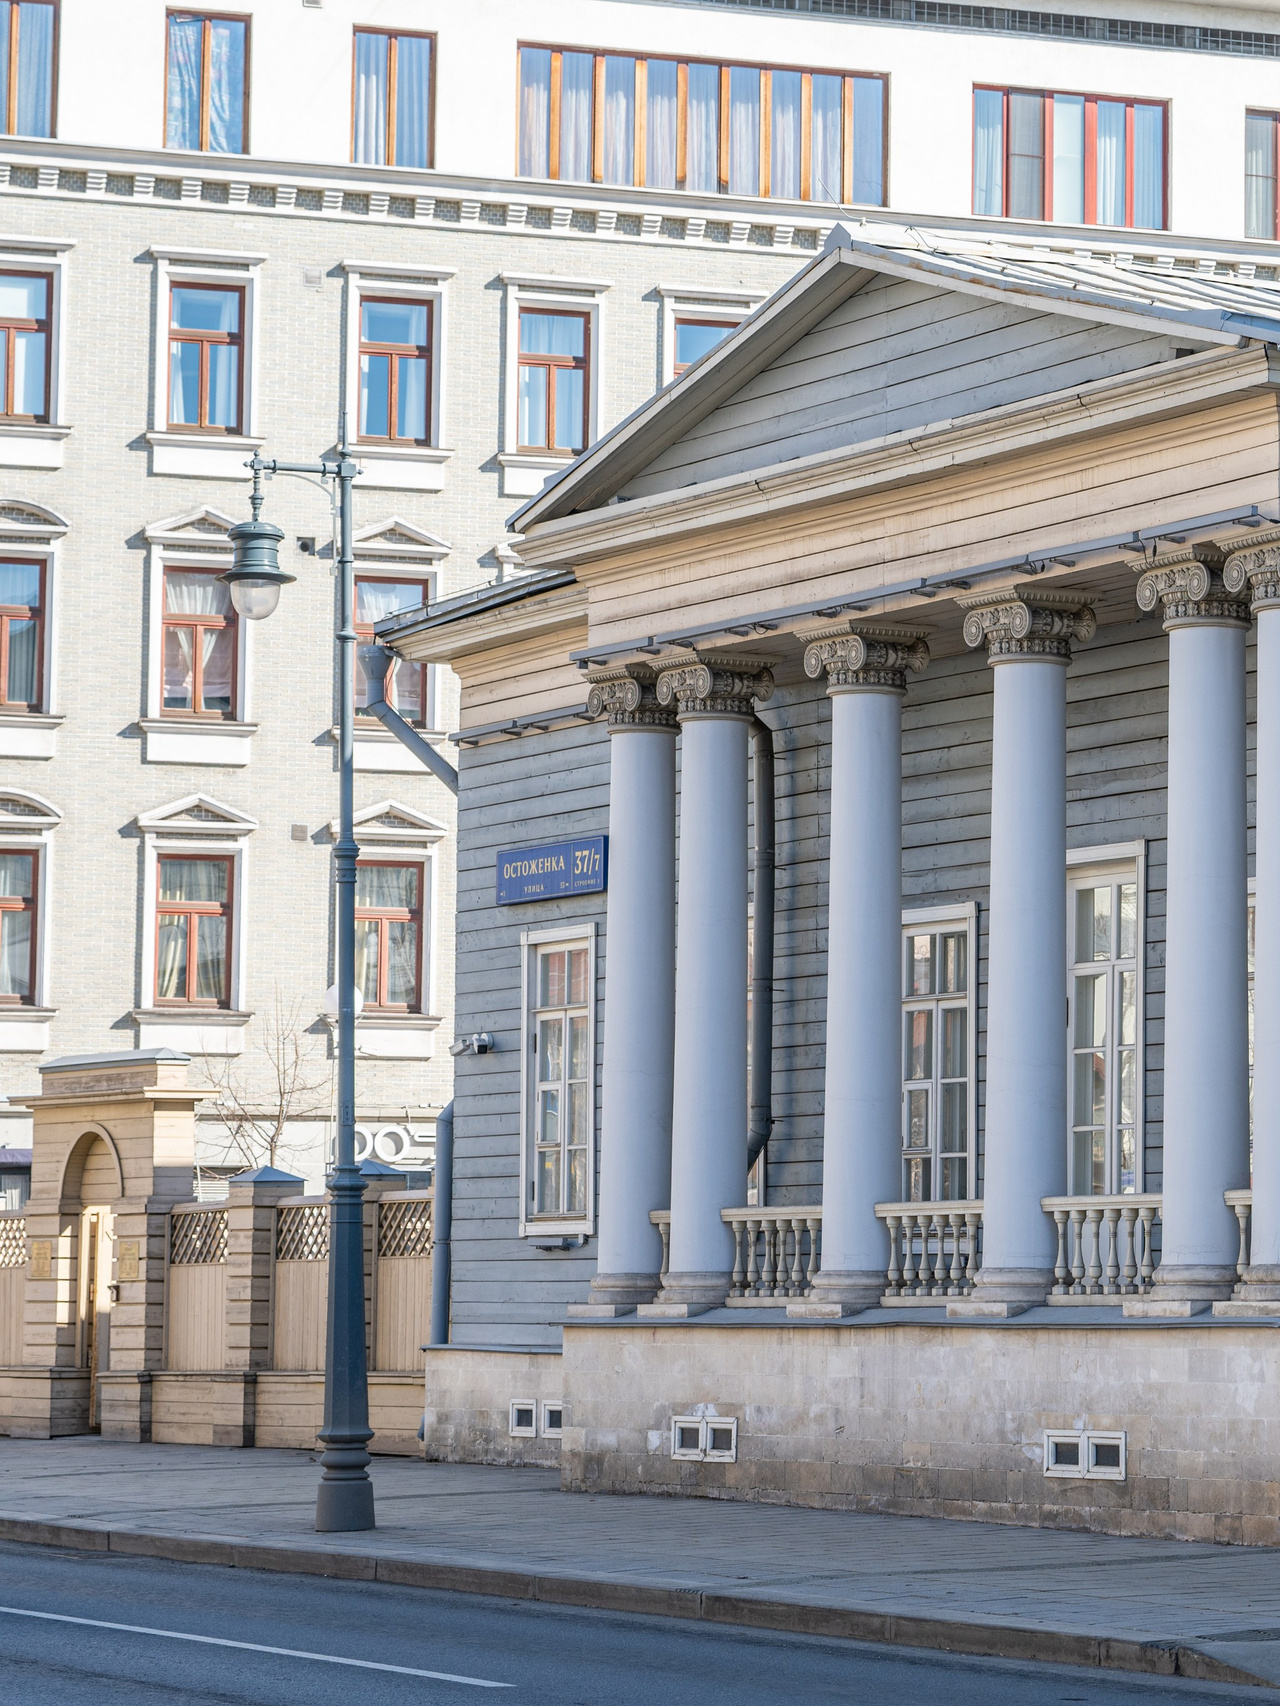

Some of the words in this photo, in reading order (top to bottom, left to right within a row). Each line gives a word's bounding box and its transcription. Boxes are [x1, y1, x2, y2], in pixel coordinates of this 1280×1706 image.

[503, 855, 565, 879] ОСТОЖЕНКА
[574, 848, 600, 875] 37/7
[524, 883, 544, 894] УЛИЦА
[574, 879, 596, 888] СТРОЕНИЕ
